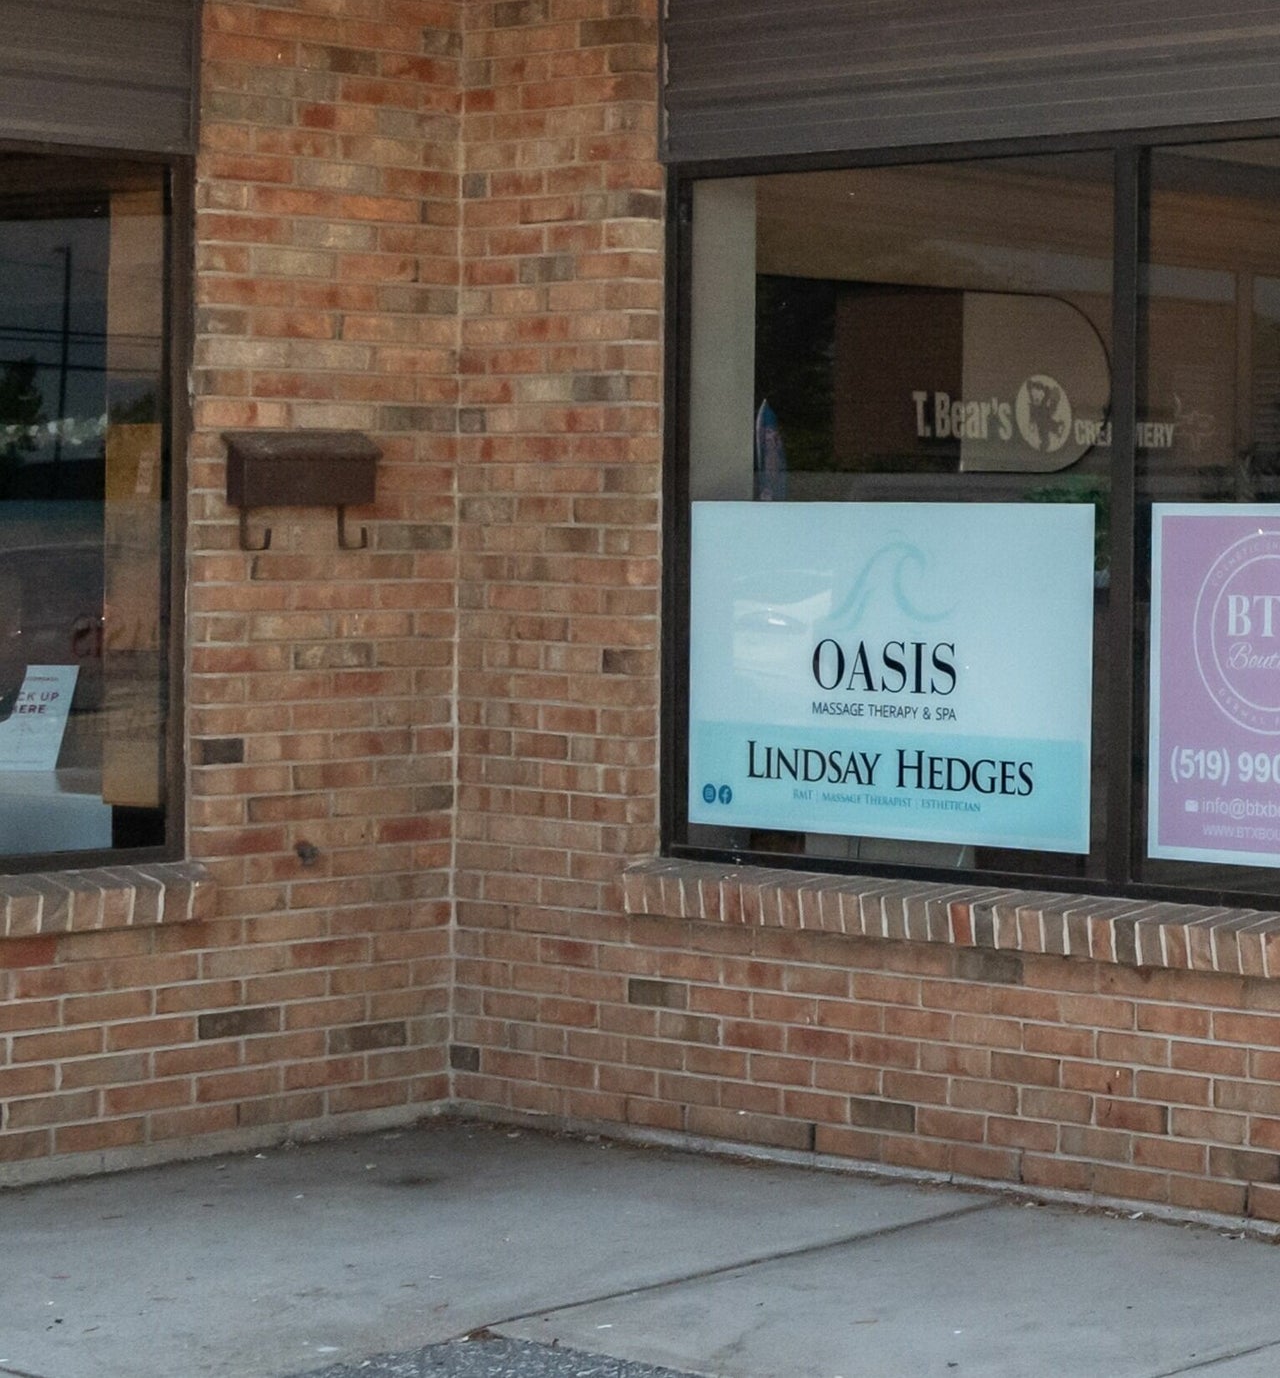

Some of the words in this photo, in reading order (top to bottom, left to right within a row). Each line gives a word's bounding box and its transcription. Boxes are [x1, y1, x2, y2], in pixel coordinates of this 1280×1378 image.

[812, 639, 957, 695] OASIS
[41, 692, 59, 701] UP
[812, 701, 864, 717] MASSAGE
[868, 703, 919, 720] THERAPY
[923, 707, 932, 721] &
[935, 707, 957, 722] SPA
[746, 740, 882, 786] LINDSAY
[896, 748, 1034, 796] HEDGES
[1170, 744, 1231, 786] (519)
